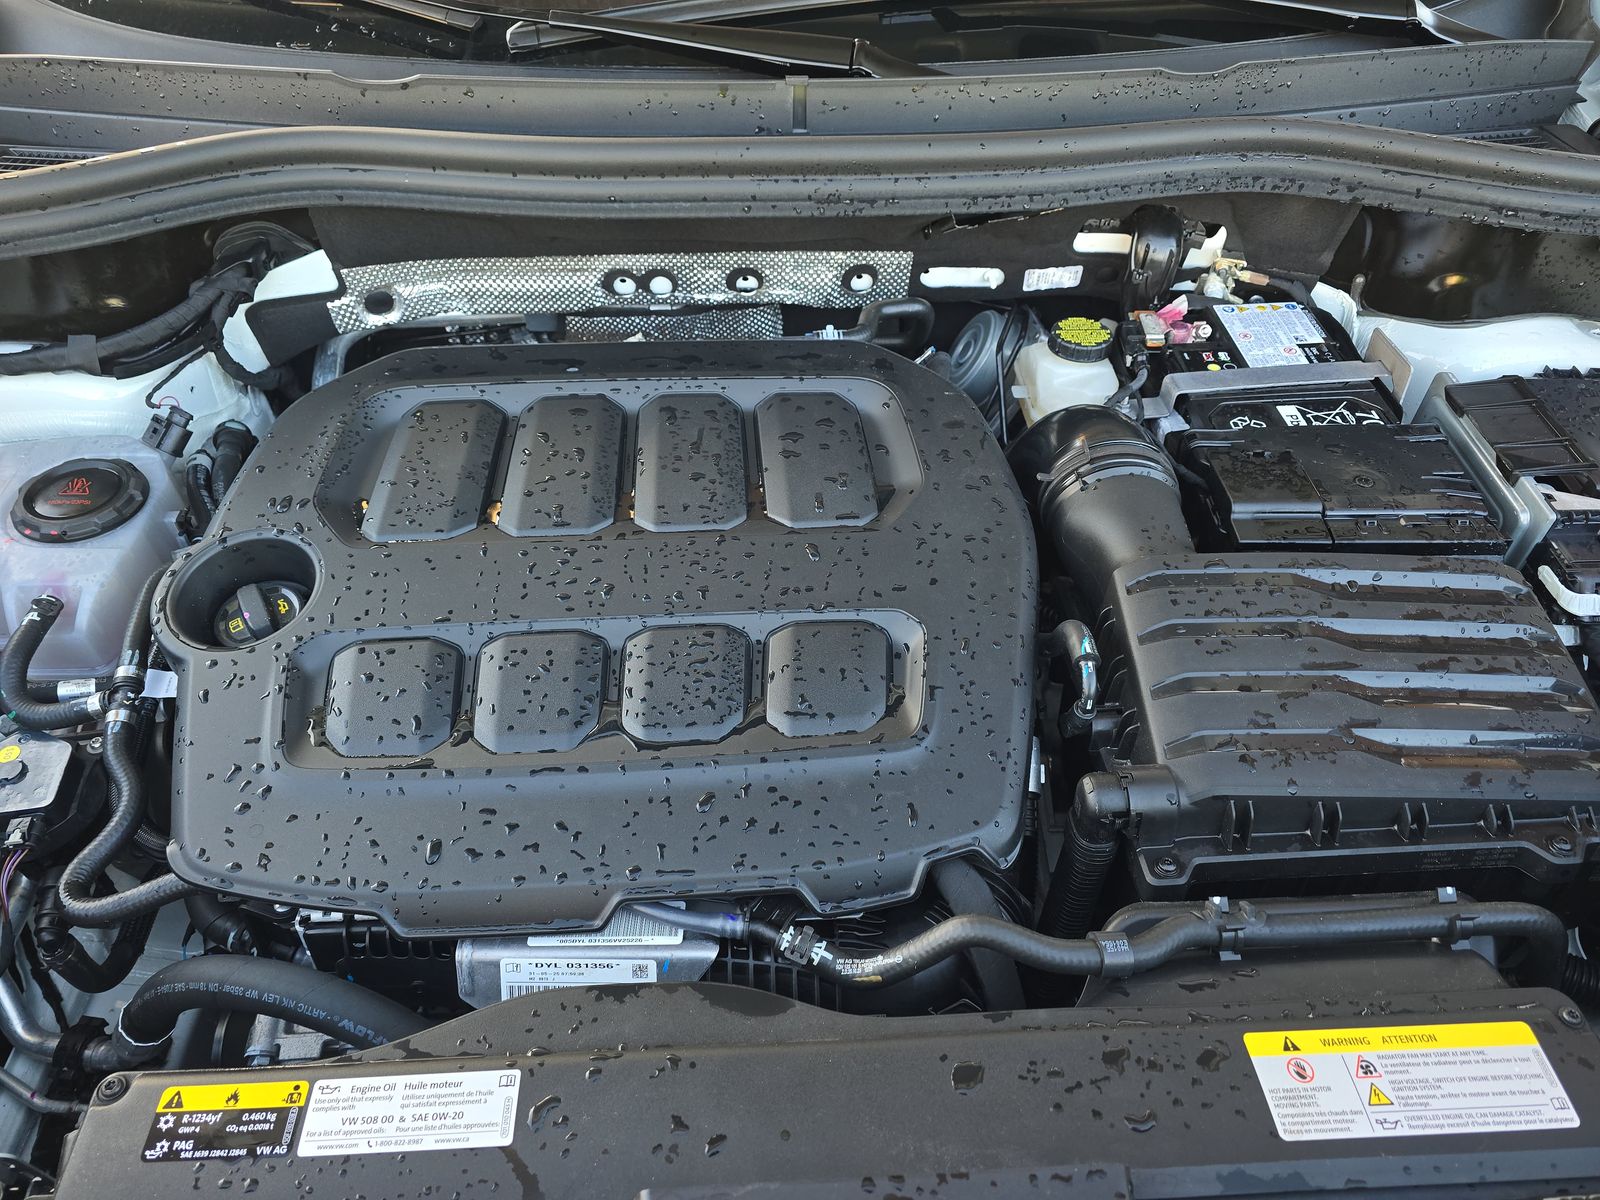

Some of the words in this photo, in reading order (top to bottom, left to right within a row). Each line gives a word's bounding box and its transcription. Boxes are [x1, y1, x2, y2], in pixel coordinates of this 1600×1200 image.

[208, 982, 219, 992] DN
[222, 985, 243, 996] 35bar
[245, 988, 259, 1000] WP
[262, 993, 280, 1004] LEV
[281, 1000, 295, 1008] NK
[298, 1003, 327, 1020] ARTIC
[1319, 1036, 1370, 1047] WARNING
[1381, 1033, 1438, 1044] ATTENTION
[350, 1084, 381, 1095] Engine
[383, 1083, 397, 1091] Oil
[404, 1082, 428, 1090] Huile
[430, 1081, 463, 1089] moteur
[426, 1092, 465, 1100] uniquement
[438, 1098, 482, 1107] expressément
[182, 1112, 223, 1125] R-1234yf
[242, 1113, 265, 1121] 0.460
[266, 1112, 277, 1122] kg
[341, 1116, 359, 1126] VW
[360, 1116, 379, 1125] 508
[381, 1115, 394, 1124] 00
[411, 1113, 429, 1122] SAE
[431, 1111, 464, 1121] 0W-20
[1277, 1111, 1313, 1119] Composants
[1287, 1119, 1332, 1127] compartiment
[343, 1128, 372, 1137] approved
[173, 1140, 194, 1150] PAG
[374, 1139, 423, 1147] 1-800-822-8987
[193, 1150, 209, 1158] J639
[256, 1146, 274, 1155] VW
[274, 1146, 287, 1154] AG
